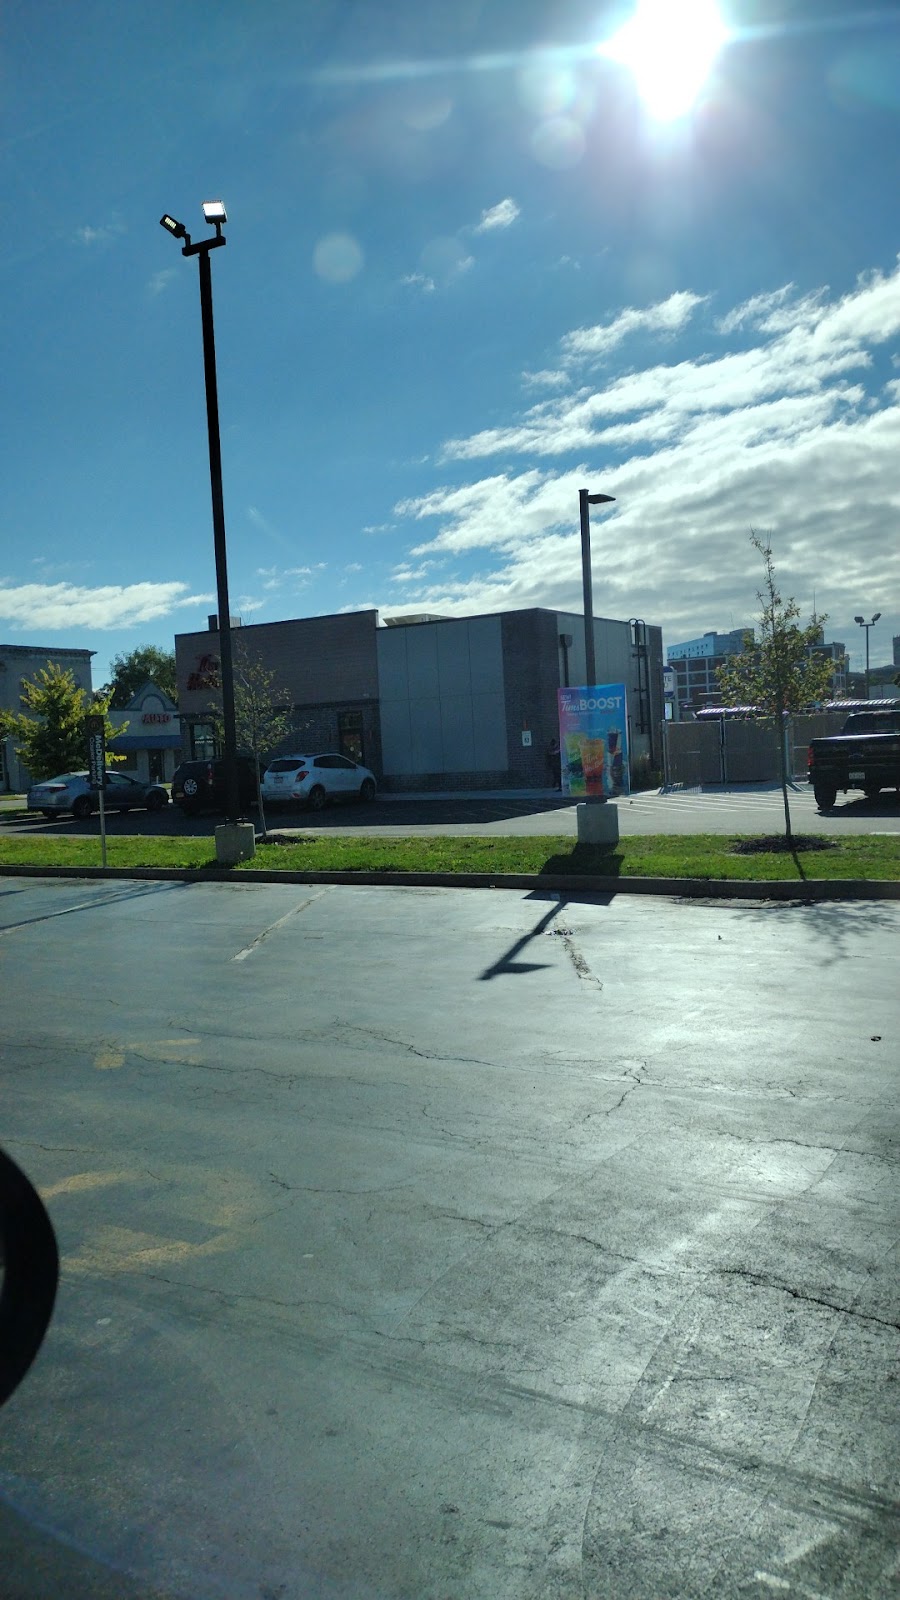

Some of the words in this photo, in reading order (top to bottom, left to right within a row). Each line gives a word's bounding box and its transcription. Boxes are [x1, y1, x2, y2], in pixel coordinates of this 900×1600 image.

[579, 696, 623, 711] BOOST
[143, 713, 170, 724] AUTO
[95, 735, 103, 785] McDelivery
